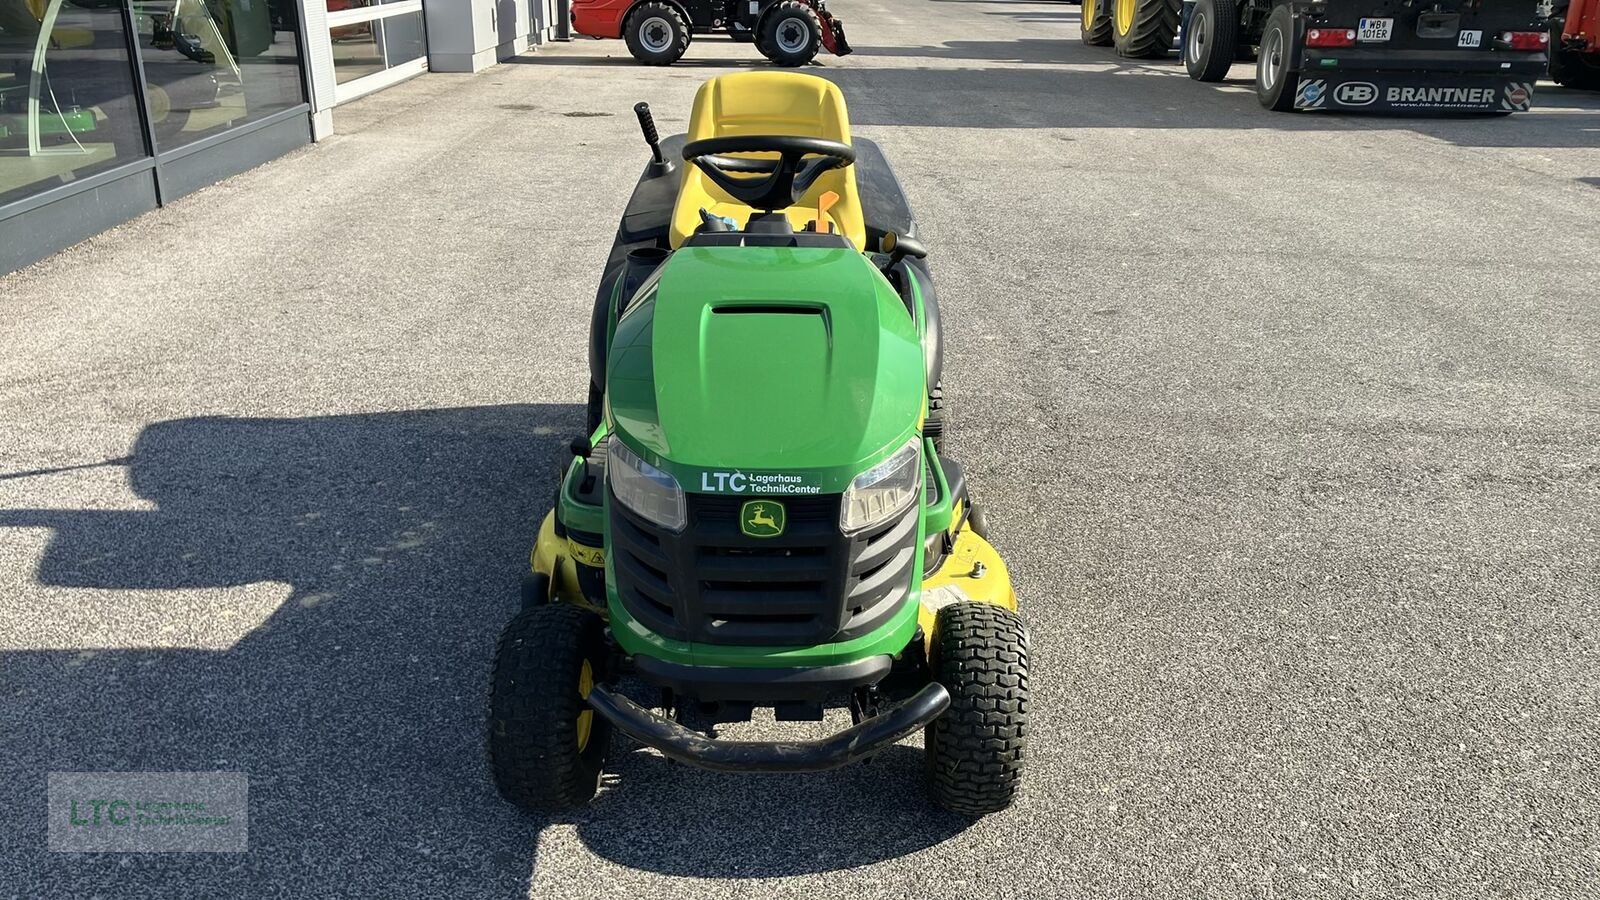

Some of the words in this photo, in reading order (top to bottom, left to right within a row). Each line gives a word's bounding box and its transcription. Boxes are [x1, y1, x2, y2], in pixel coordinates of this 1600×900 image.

[1369, 20, 1381, 29] WB
[1362, 29, 1387, 38] 101ER
[1341, 86, 1372, 101] HB
[1386, 87, 1496, 103] BRANTNER
[701, 471, 747, 492] LTC
[749, 473, 802, 484] Lagerhaus
[749, 483, 821, 494] TechnikCenter
